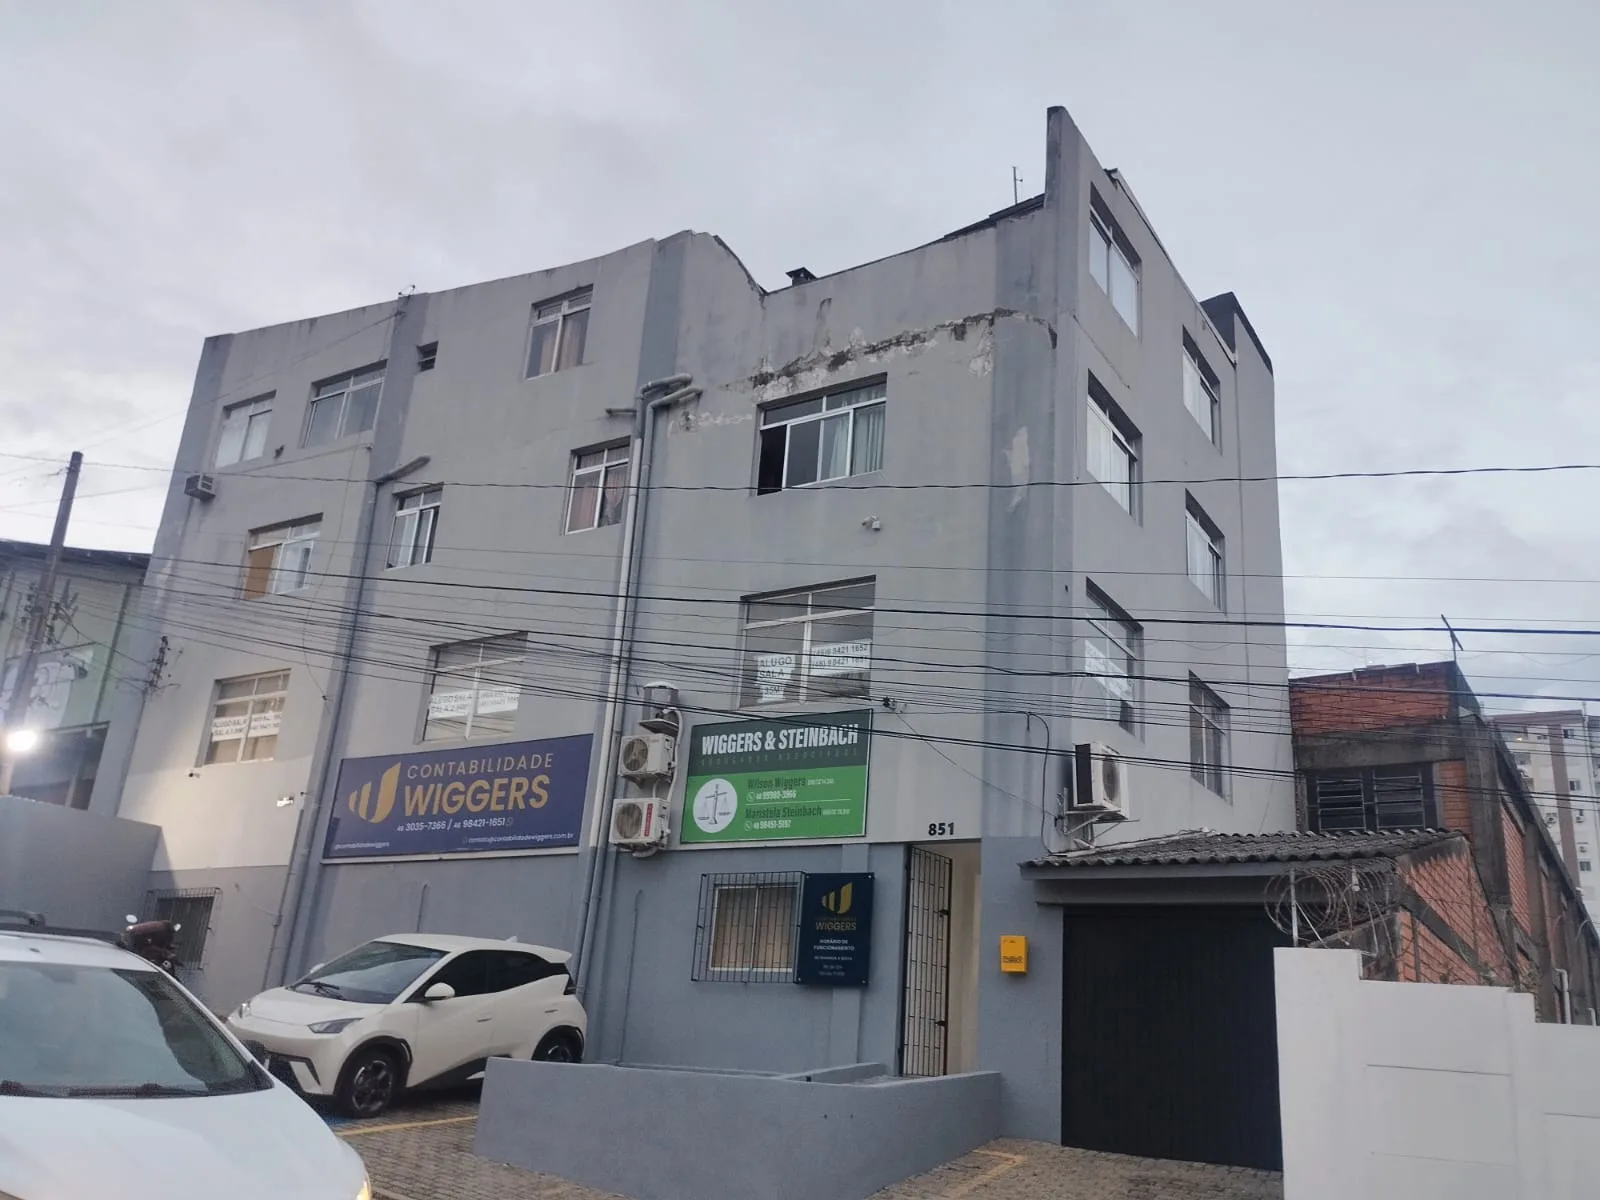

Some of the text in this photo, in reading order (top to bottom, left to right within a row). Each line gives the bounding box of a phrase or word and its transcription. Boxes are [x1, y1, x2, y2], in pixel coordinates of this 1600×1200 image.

[760, 656, 792, 668] ALUGO
[702, 724, 858, 755] WIGGERS & STEINBACH
[407, 753, 554, 780] CONTABILIDADE
[774, 776, 805, 791] Wiggers
[404, 774, 551, 818] WIGGERS
[782, 804, 822, 818] Steinbach
[405, 820, 446, 832] 3035-7366
[928, 821, 954, 836] 851
[468, 832, 574, 844] @contabilidadewiggers.com.br
[816, 922, 856, 931] WIGGERS
